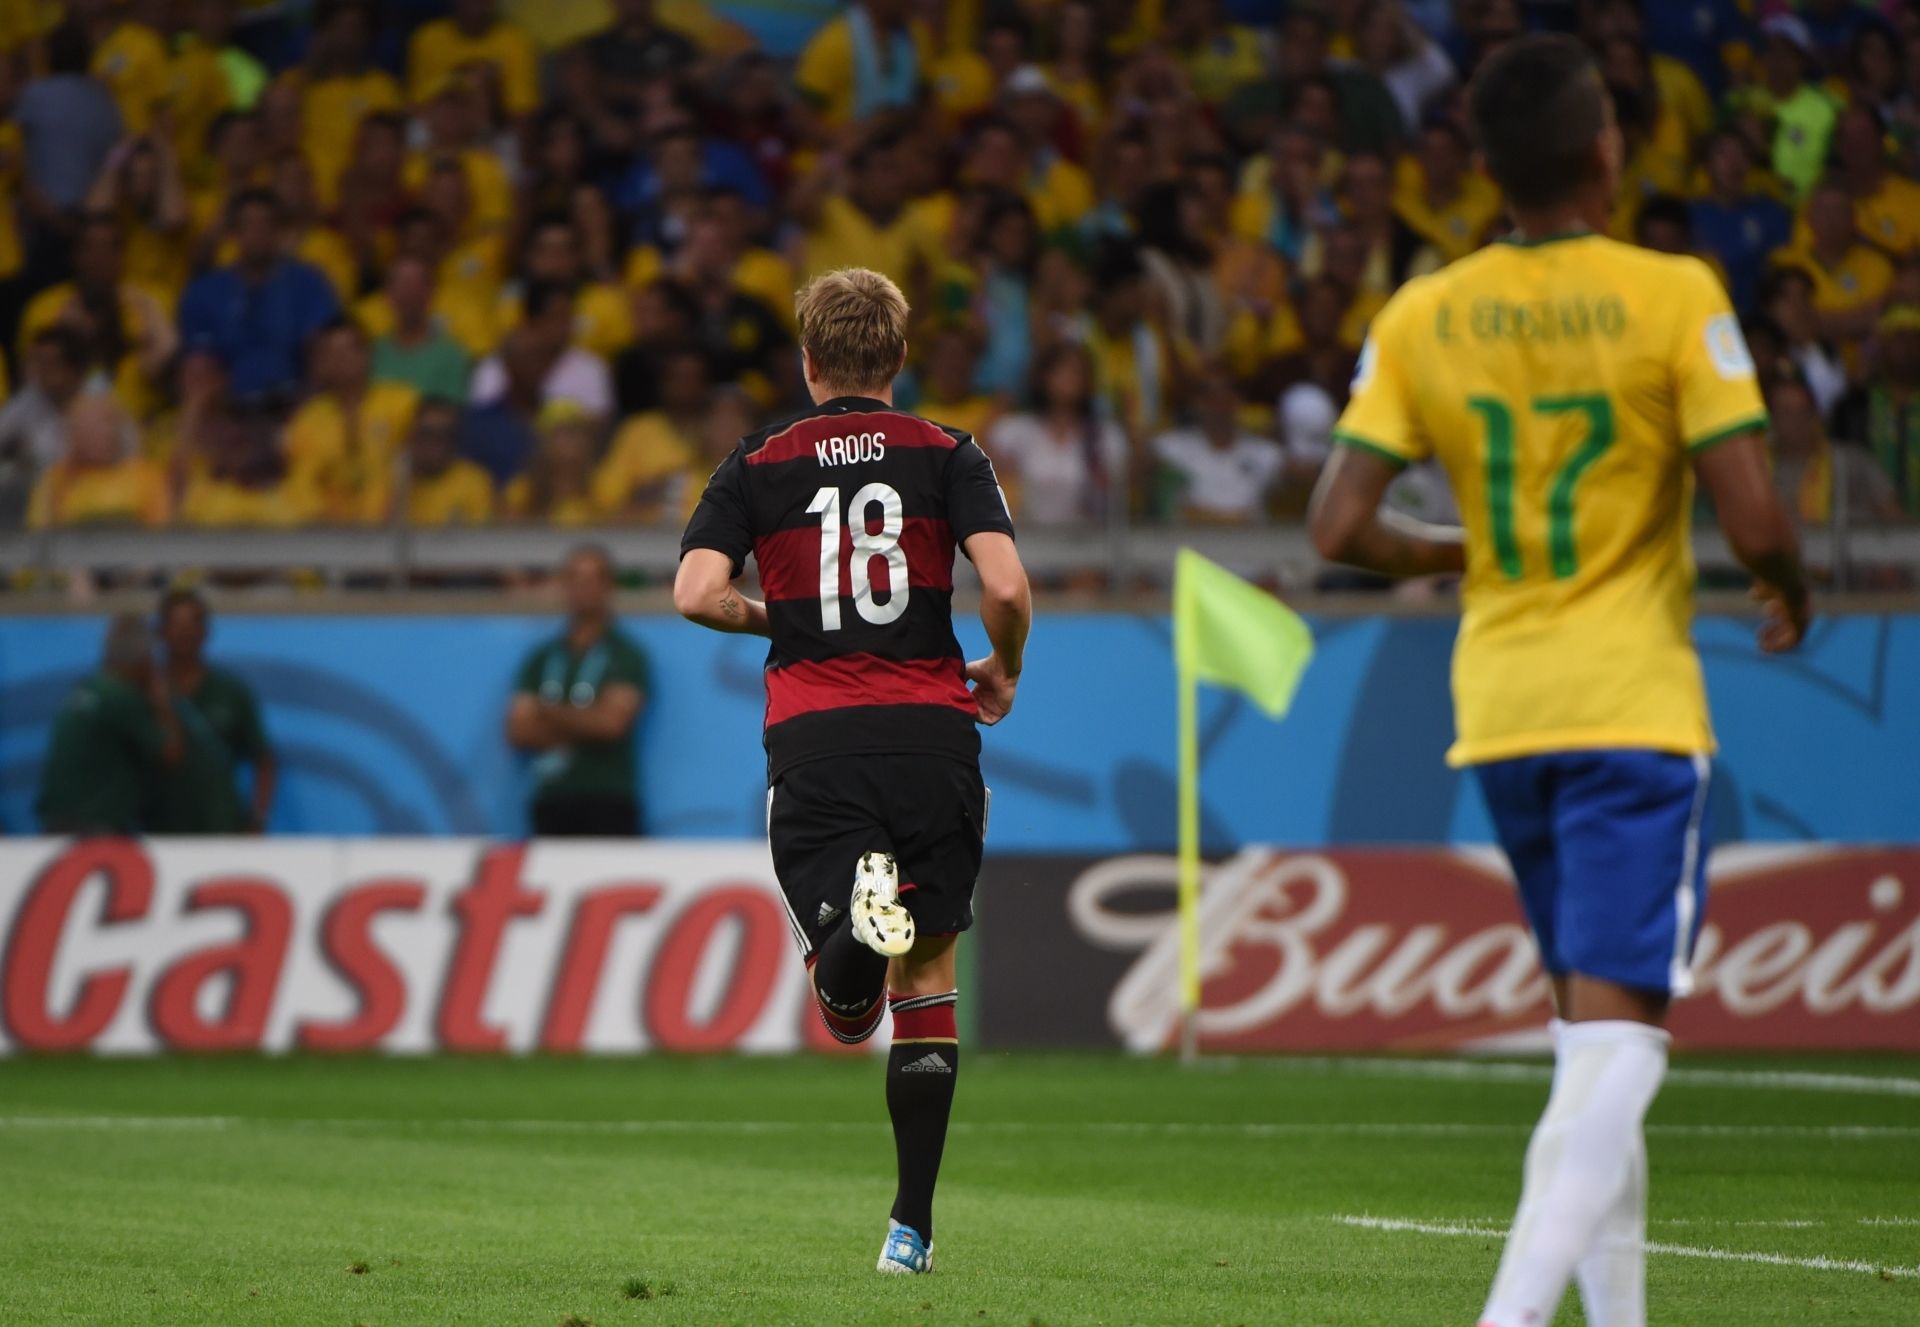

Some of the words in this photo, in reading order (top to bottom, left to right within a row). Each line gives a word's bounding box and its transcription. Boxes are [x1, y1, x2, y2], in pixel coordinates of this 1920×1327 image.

[815, 432, 886, 467] KROOS
[1466, 389, 1617, 580] 17
[805, 482, 910, 631] 18
[901, 1063, 952, 1073] adidas
